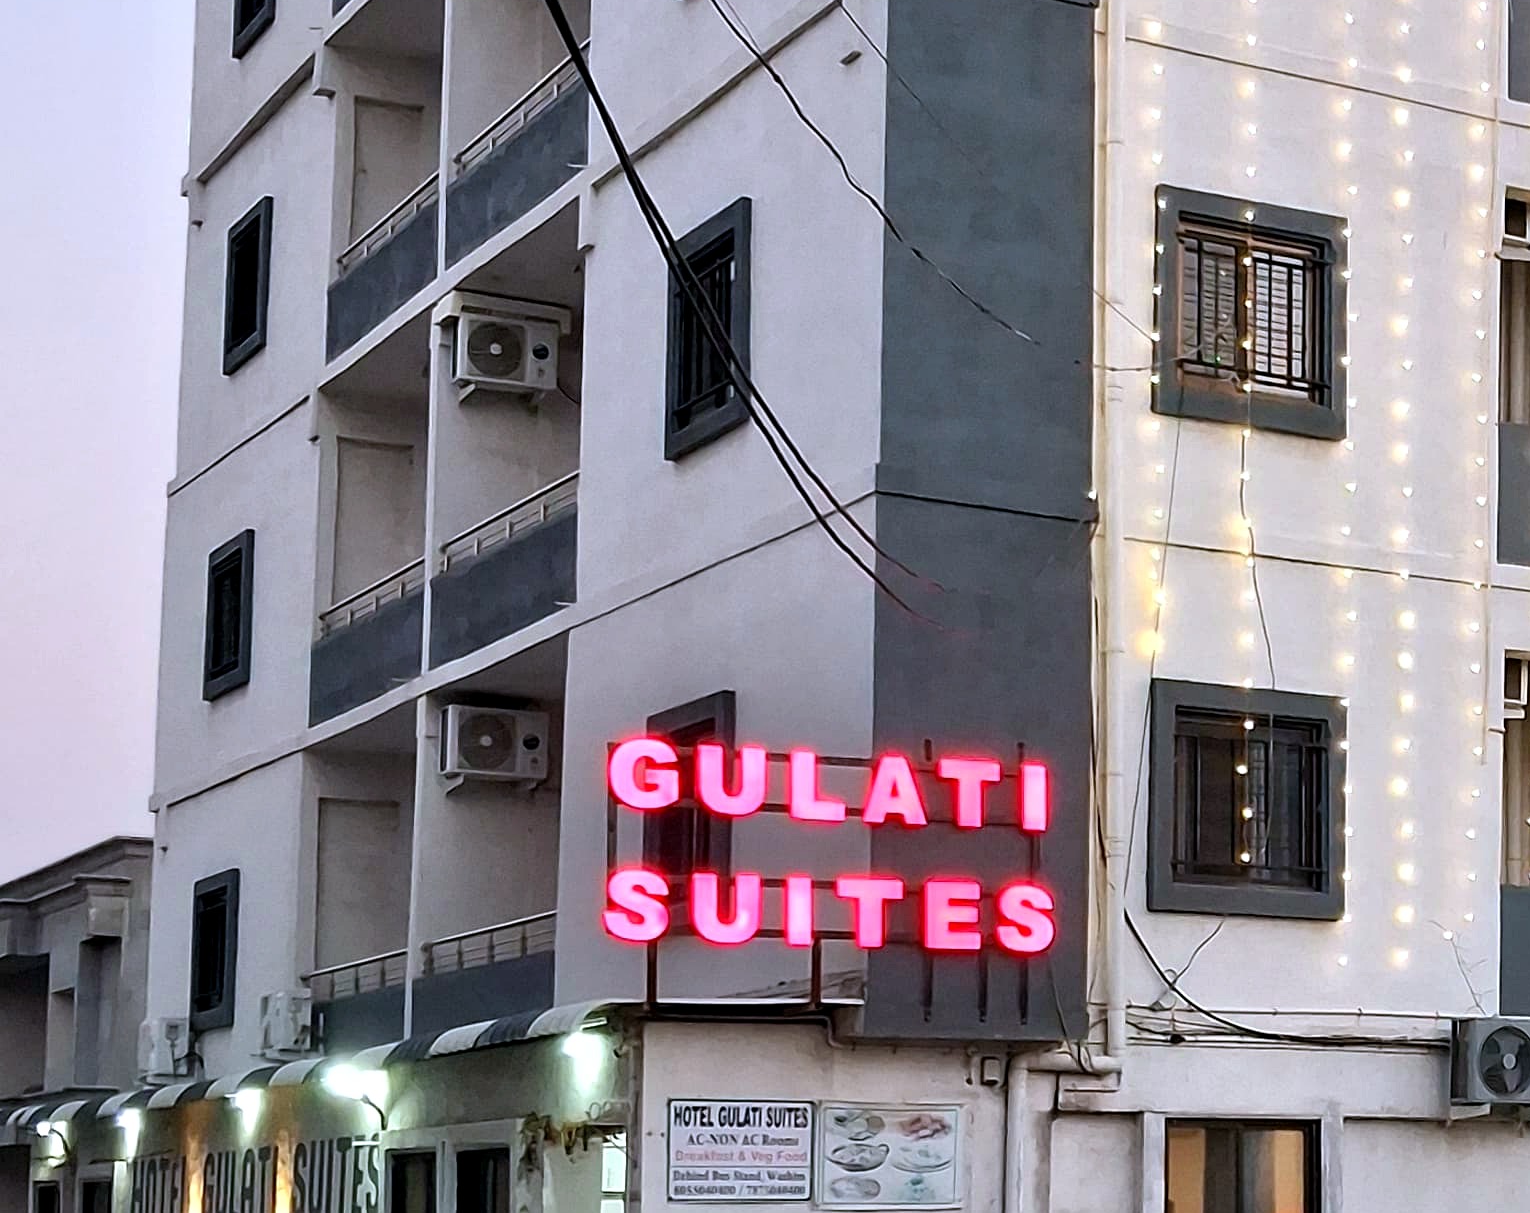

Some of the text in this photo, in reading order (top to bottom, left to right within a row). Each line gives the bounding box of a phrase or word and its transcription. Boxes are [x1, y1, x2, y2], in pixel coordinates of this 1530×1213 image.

[607, 735, 1049, 833] GULATI
[602, 866, 1057, 954] SUITES
[674, 1105, 809, 1129] HOTEL GULATI SUITES
[687, 1133, 799, 1146] AC-NON AC Rooms
[291, 1132, 381, 1213] SUITES
[675, 1150, 807, 1163] Breakfast & Veg Food
